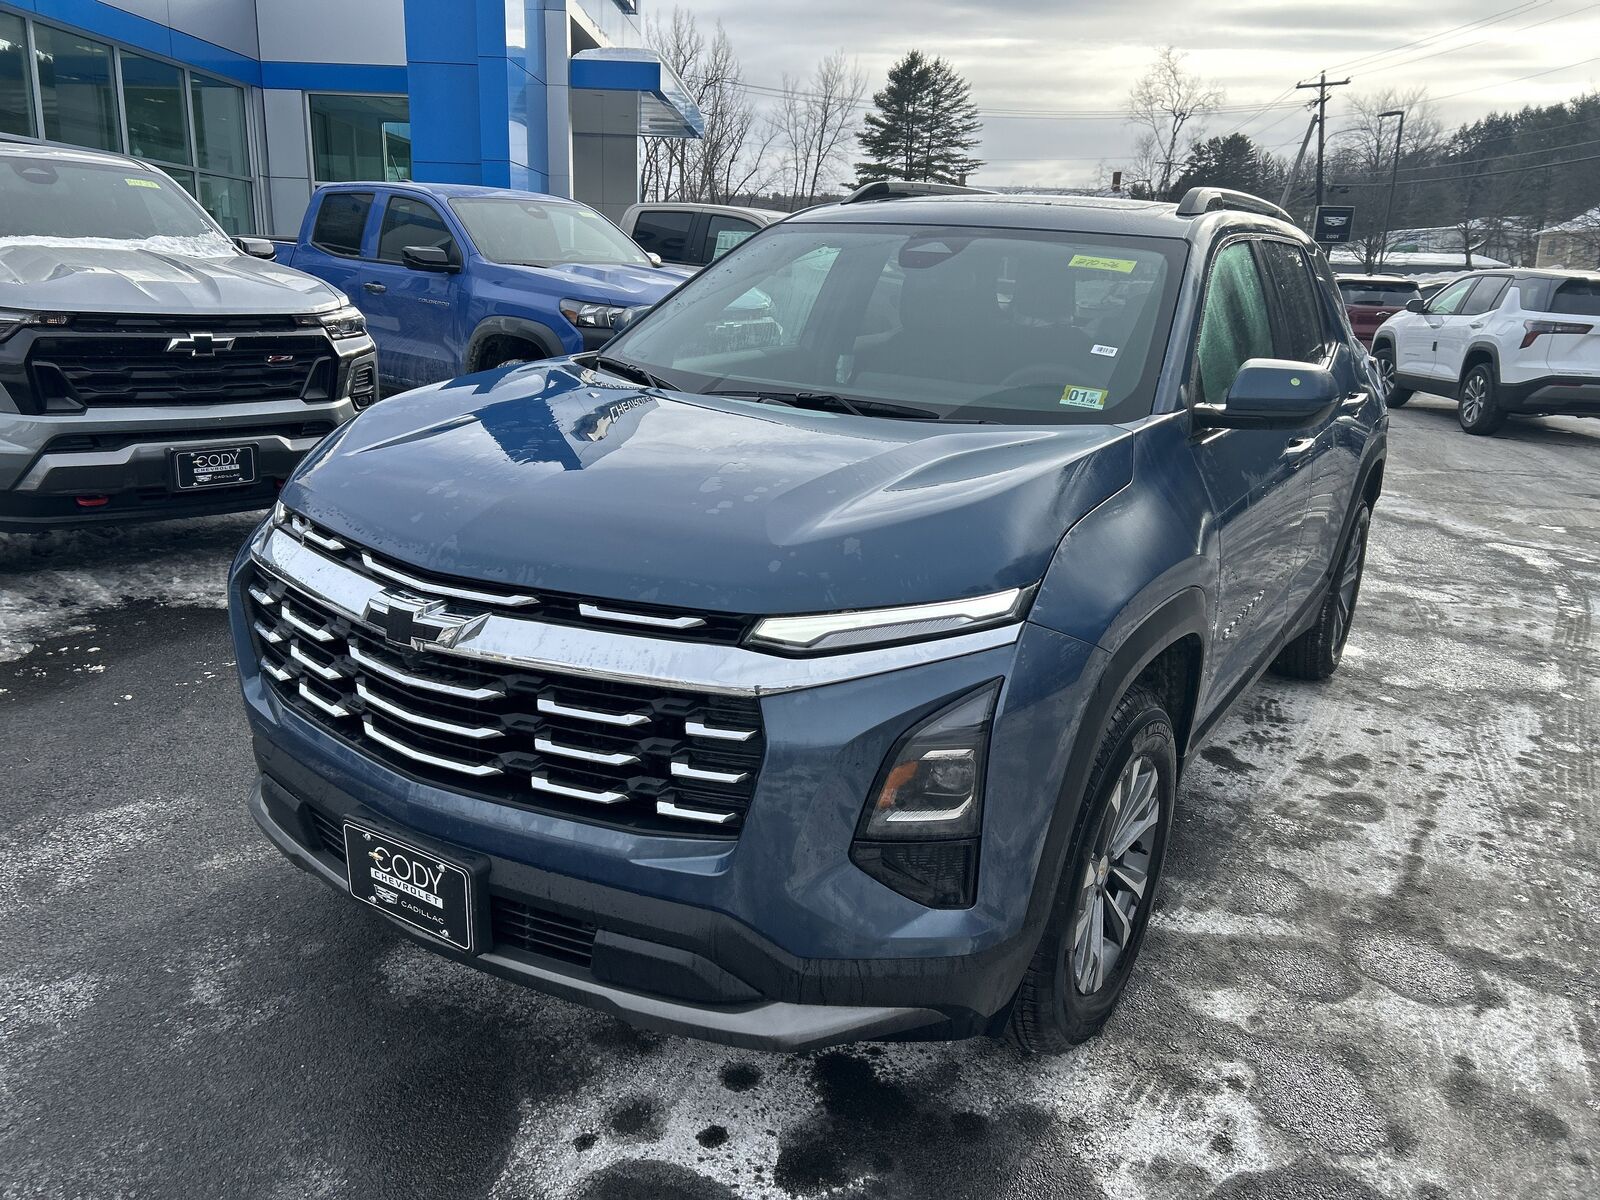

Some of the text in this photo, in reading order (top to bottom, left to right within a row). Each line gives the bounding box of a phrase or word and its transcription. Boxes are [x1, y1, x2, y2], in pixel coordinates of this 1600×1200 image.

[1069, 389, 1088, 403] 01
[195, 452, 240, 468] CODY
[195, 464, 239, 473] CHEVROLET
[373, 846, 443, 895] CODY
[372, 870, 441, 907] CHEVROLET
[400, 900, 445, 925] CADILLAC
